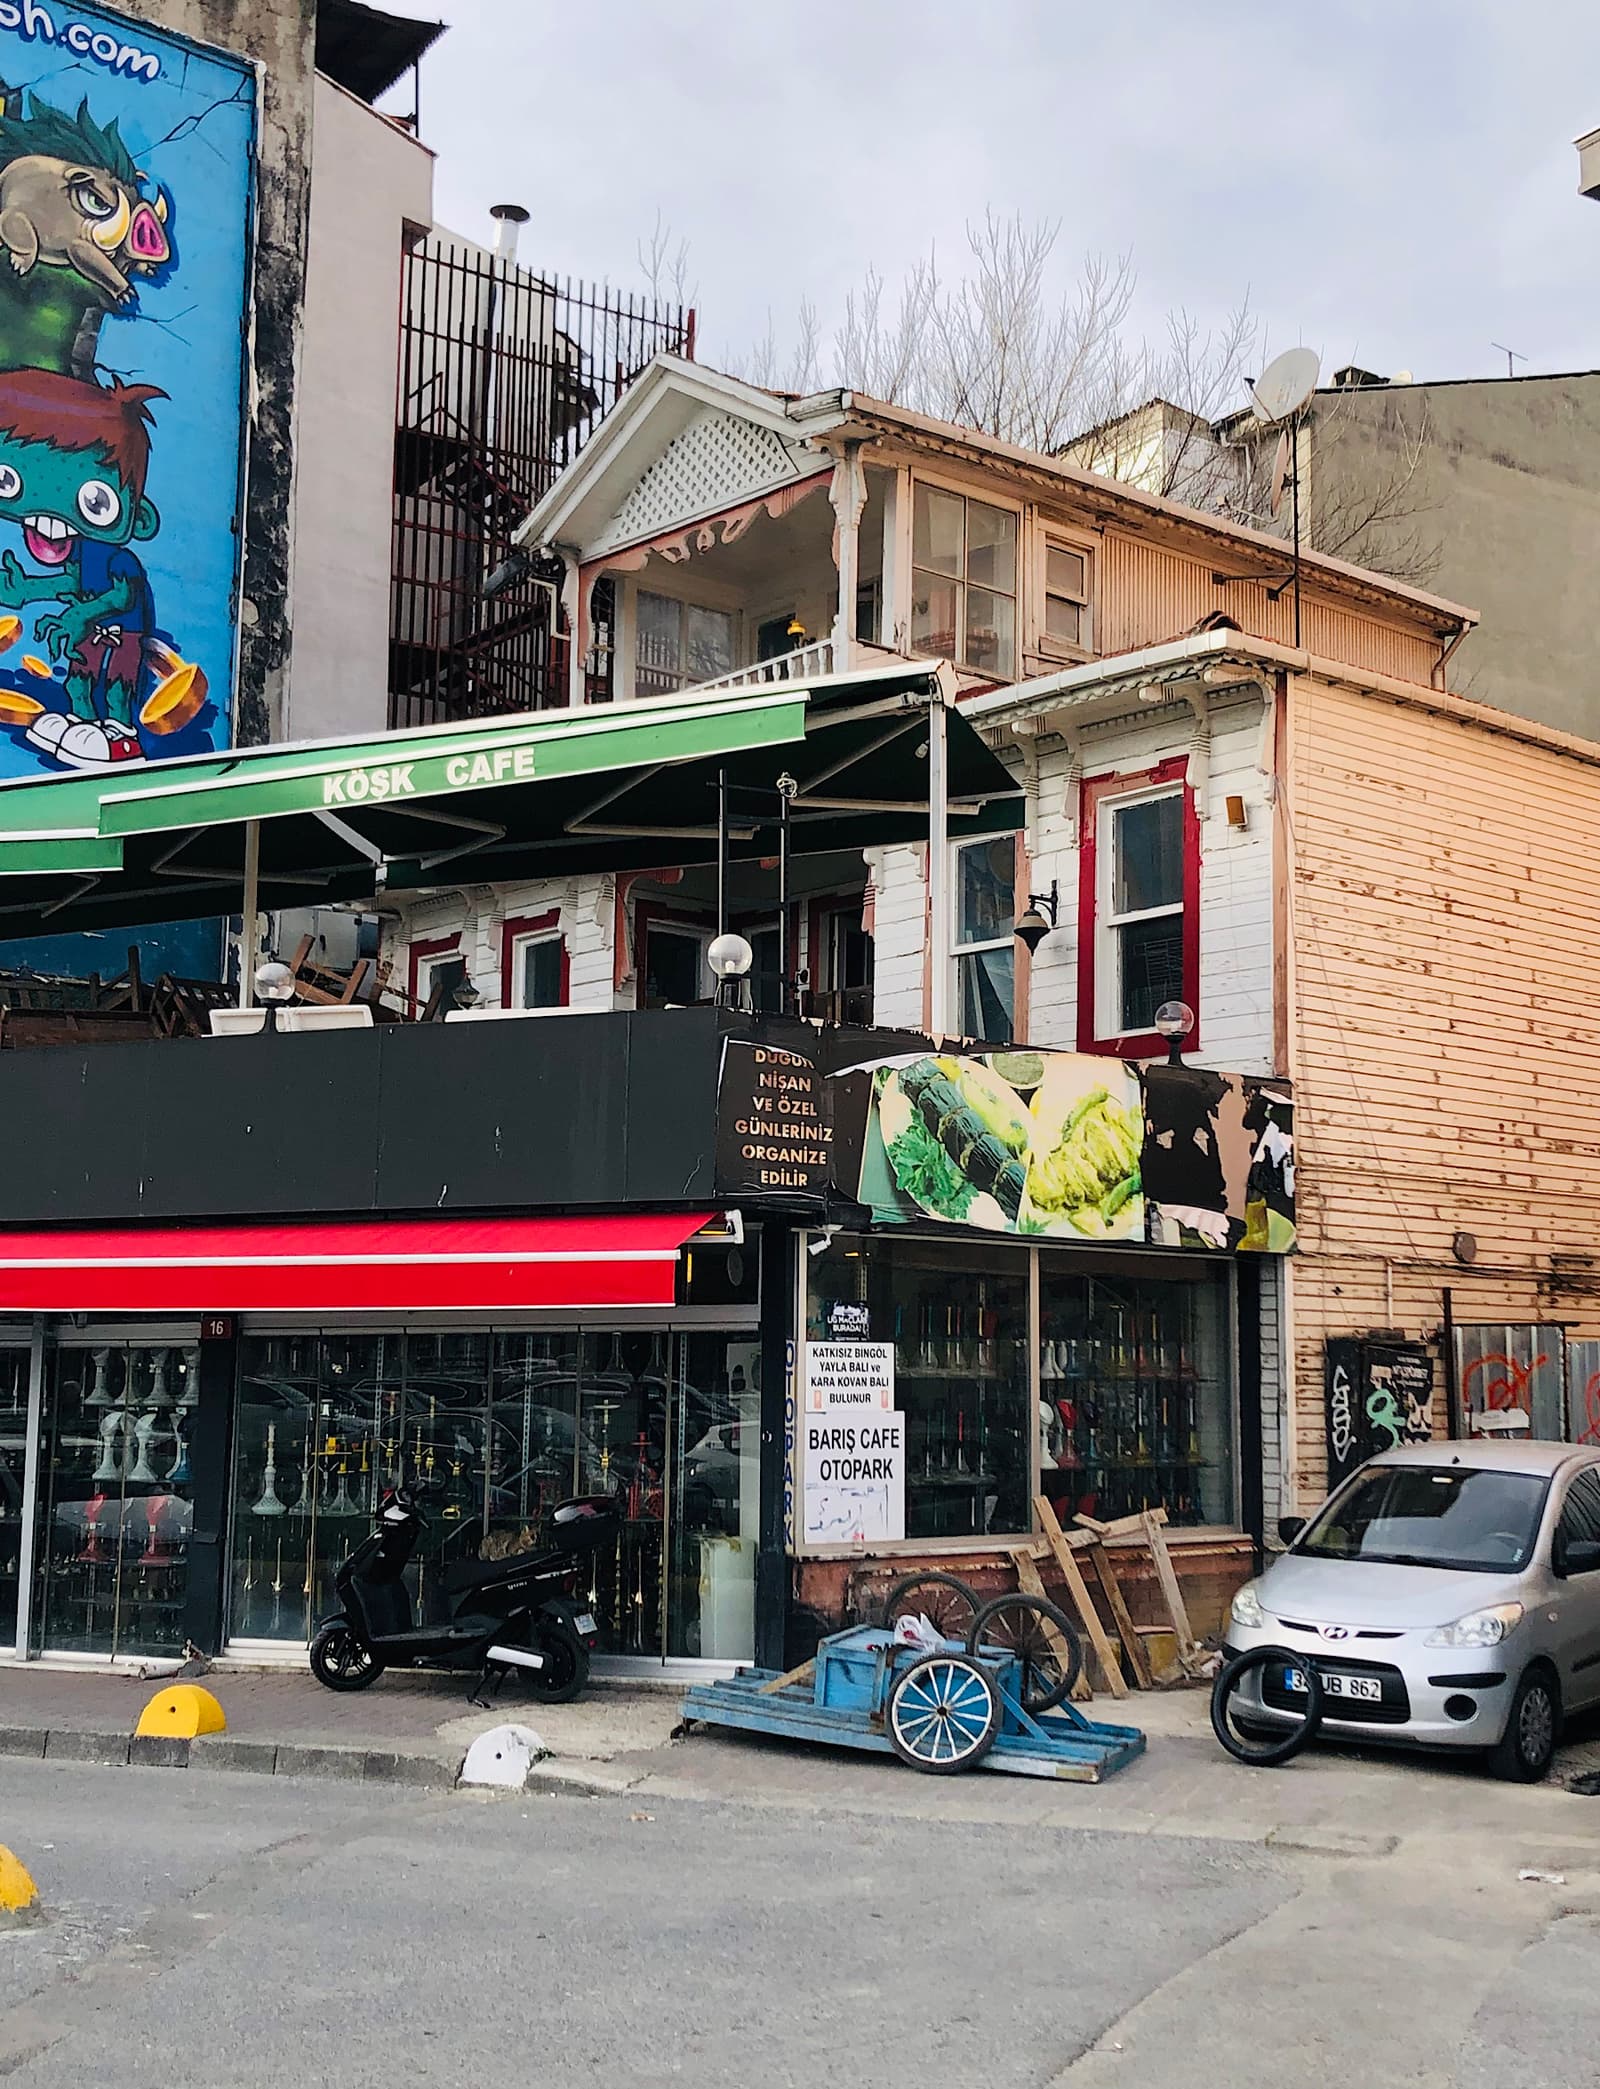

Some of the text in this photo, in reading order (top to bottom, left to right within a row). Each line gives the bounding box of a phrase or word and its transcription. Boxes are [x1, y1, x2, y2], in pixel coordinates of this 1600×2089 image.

[323, 747, 535, 804] KÖŞK CAFE
[759, 1070, 812, 1093] NİŞAN
[752, 1095, 817, 1117] VE ÖZEL
[735, 1116, 833, 1142] GÜNLERİNİZ
[741, 1144, 827, 1165] ORGANİZE
[760, 1168, 808, 1186] EDİLİR
[210, 1320, 224, 1335] 16
[812, 1347, 852, 1358] KATKISIZ
[820, 1362, 881, 1373] YAYLA BALI ve
[811, 1377, 889, 1387] KARA KOVAN BALI
[830, 1393, 871, 1403] BULUNUR
[809, 1428, 900, 1454] BARIŞ CAFE
[820, 1459, 894, 1481] OTOPARK
[1350, 1679, 1379, 1699] 862
